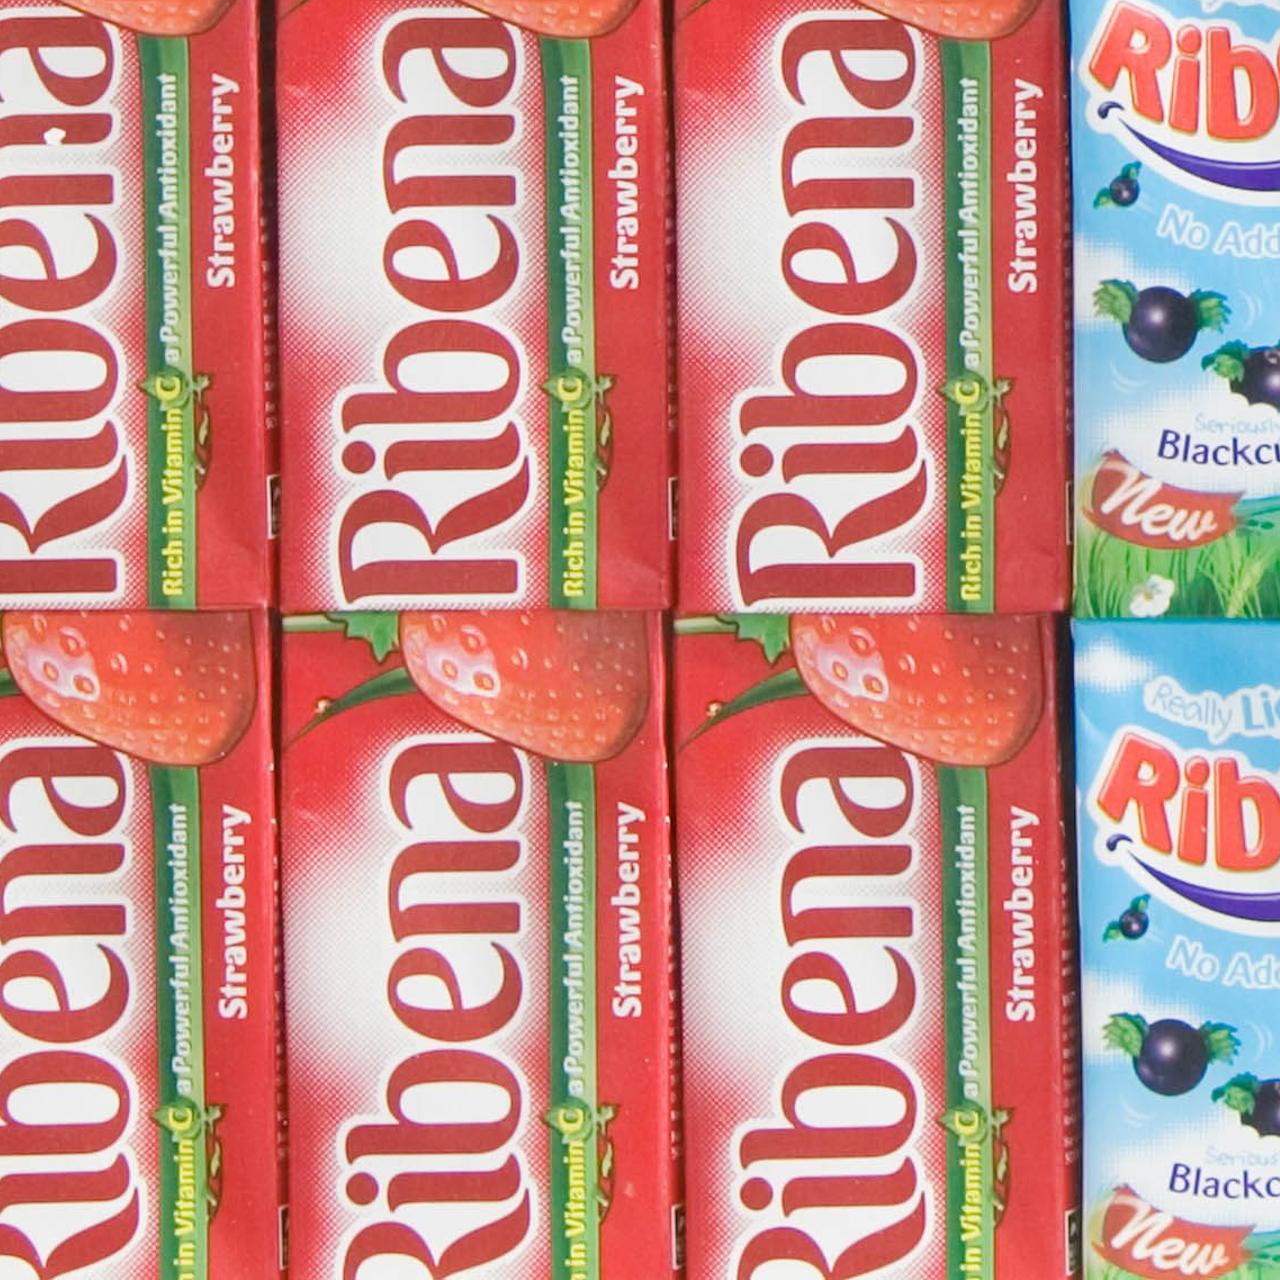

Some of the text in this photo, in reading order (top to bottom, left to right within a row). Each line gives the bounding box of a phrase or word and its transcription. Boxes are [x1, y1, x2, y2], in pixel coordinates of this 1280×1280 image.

[156, 72, 180, 366] a Powerful Antioxidant
[204, 73, 240, 288] Strawberry
[609, 75, 645, 290] Strawberry
[1008, 78, 1043, 294] Strawberry
[1164, 208, 1210, 249] No
[337, 16, 536, 605] Ribena
[735, 14, 928, 608] Ribena
[155, 376, 183, 596] Rich in Vitamin C
[1100, 477, 1217, 538] New
[218, 804, 253, 1021] Strawberry
[613, 801, 646, 1018] Strawberry
[737, 743, 927, 1280] Ribena
[1003, 805, 1040, 1022] Strawberry
[1110, 1201, 1230, 1275] New
